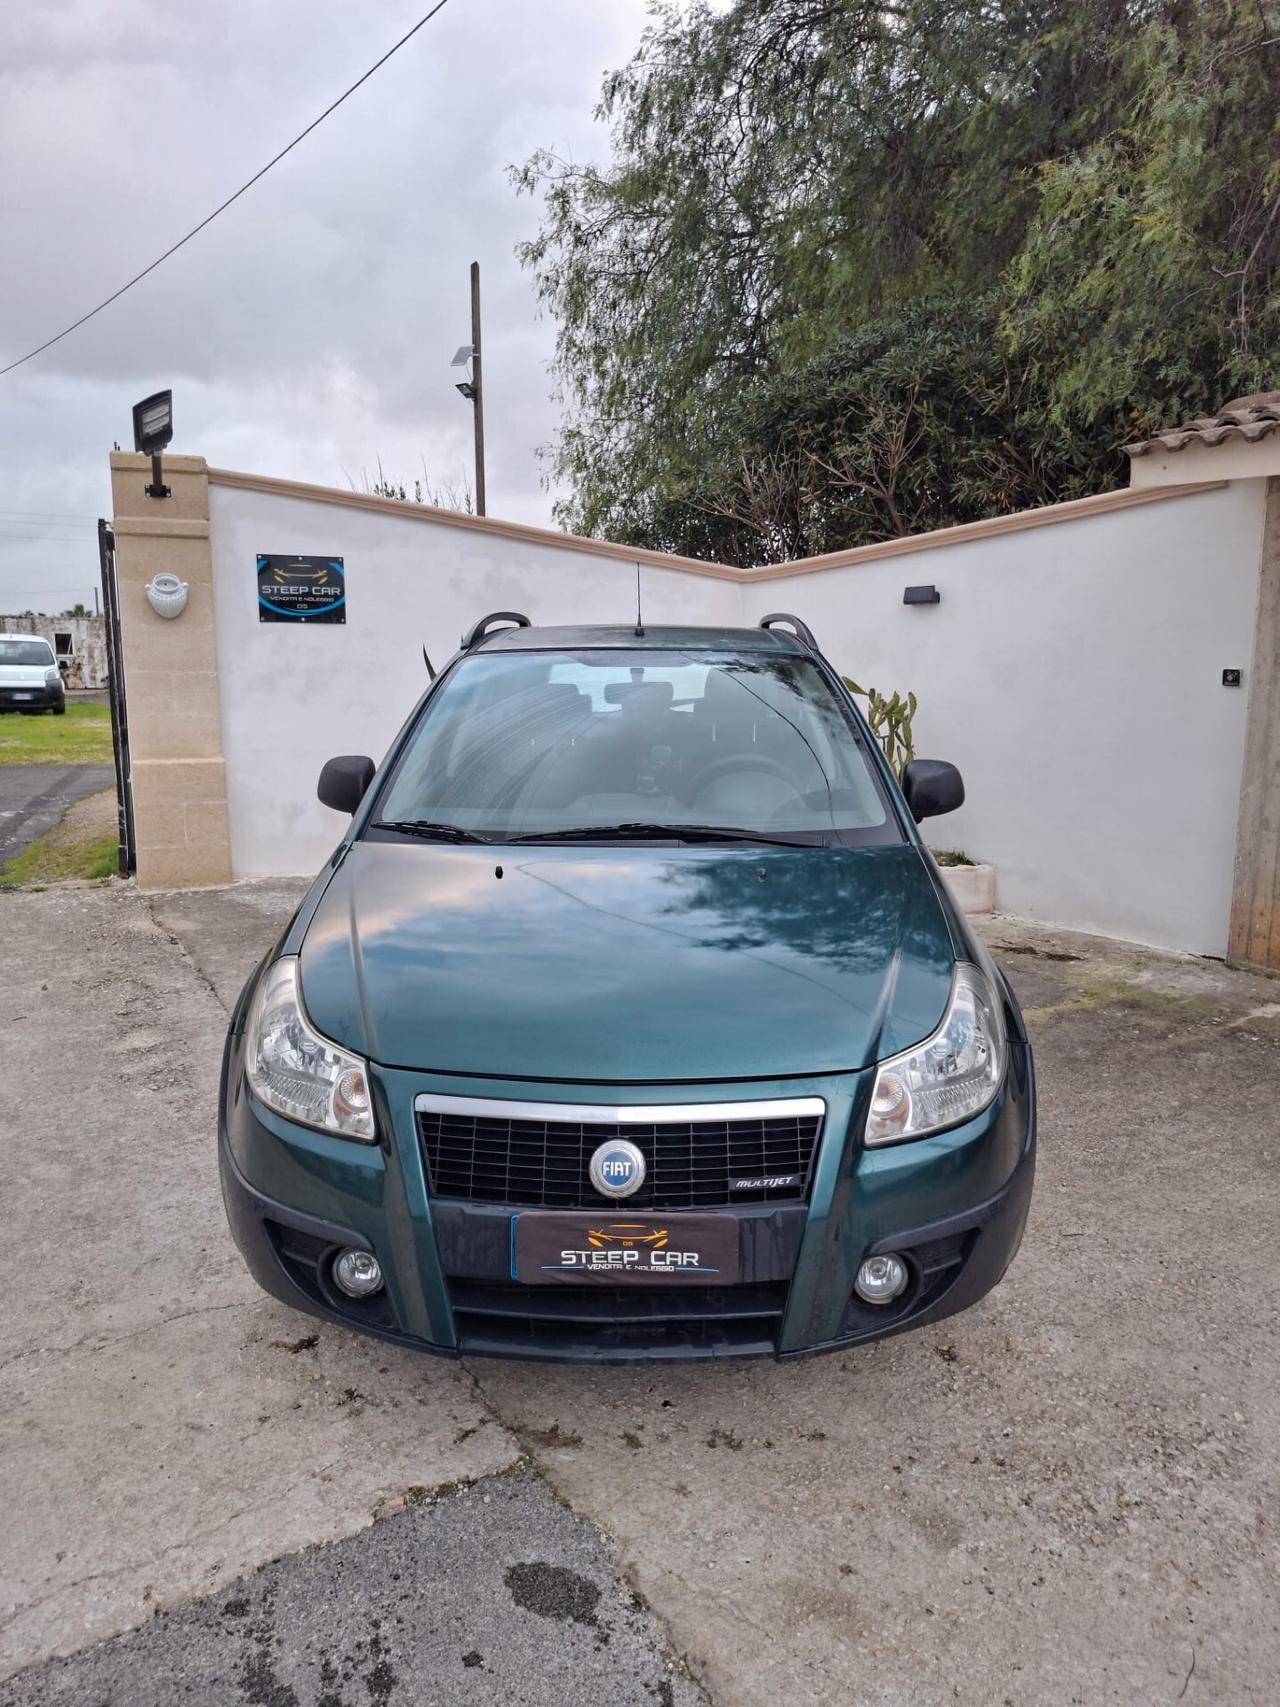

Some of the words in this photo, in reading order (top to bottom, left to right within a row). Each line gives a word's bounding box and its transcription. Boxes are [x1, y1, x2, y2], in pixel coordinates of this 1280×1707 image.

[261, 585, 309, 594] STEEP
[312, 586, 341, 595] CAR
[603, 1161, 631, 1177] FIAT
[736, 1176, 793, 1188] MULTIJET
[561, 1250, 639, 1265] STEEP
[650, 1250, 699, 1266] CAR
